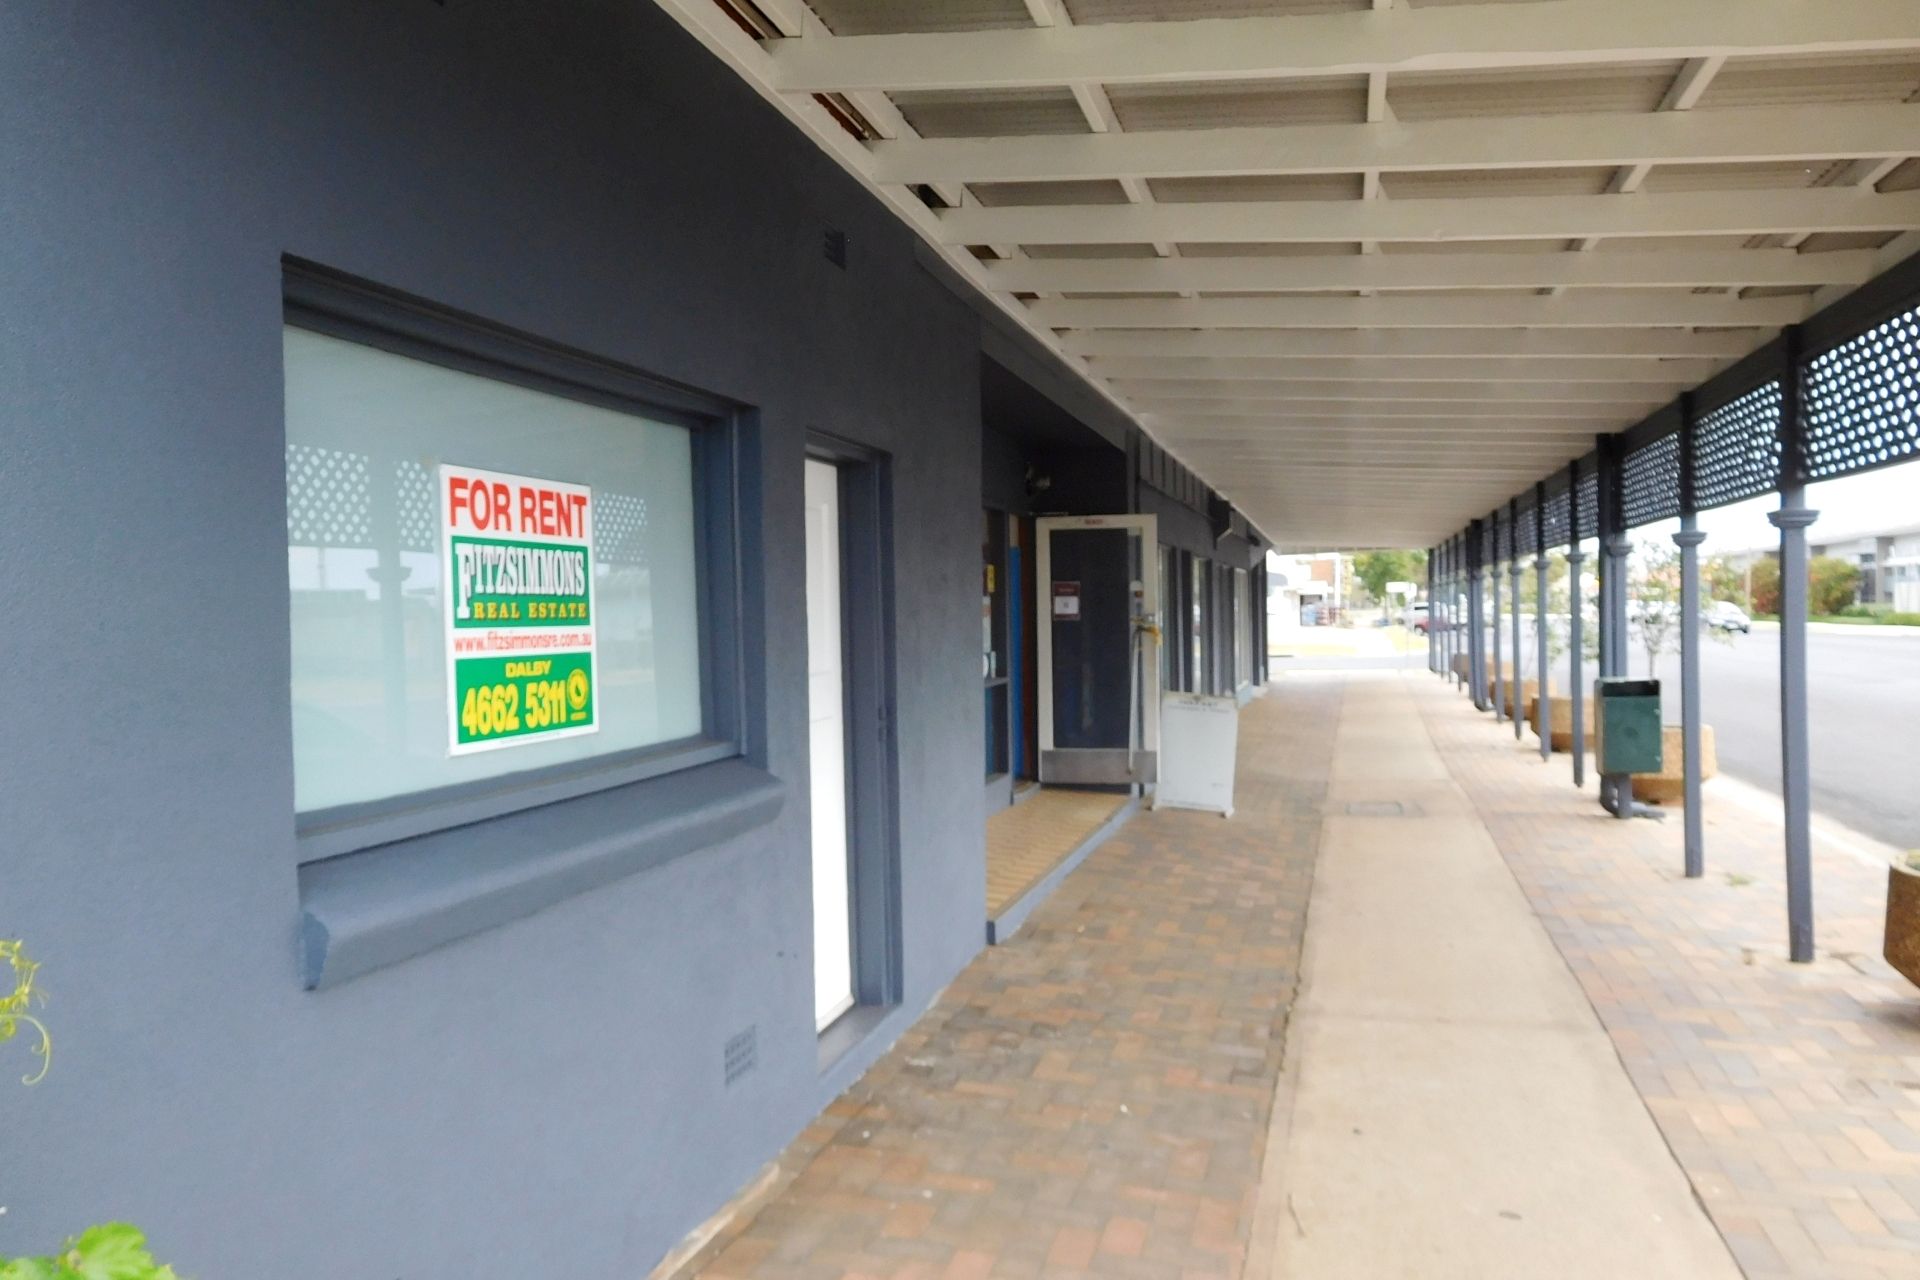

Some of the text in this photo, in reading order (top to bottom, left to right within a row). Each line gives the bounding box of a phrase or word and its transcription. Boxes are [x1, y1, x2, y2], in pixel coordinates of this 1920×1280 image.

[449, 477, 587, 538] FOR RENT
[455, 542, 585, 619] FITZSIMMONS
[473, 602, 586, 619] REAL ESTATE
[454, 631, 592, 652] www.fitzsimmonsre.com.au
[505, 660, 552, 678] DALBY
[462, 680, 566, 736] 4662 5311
